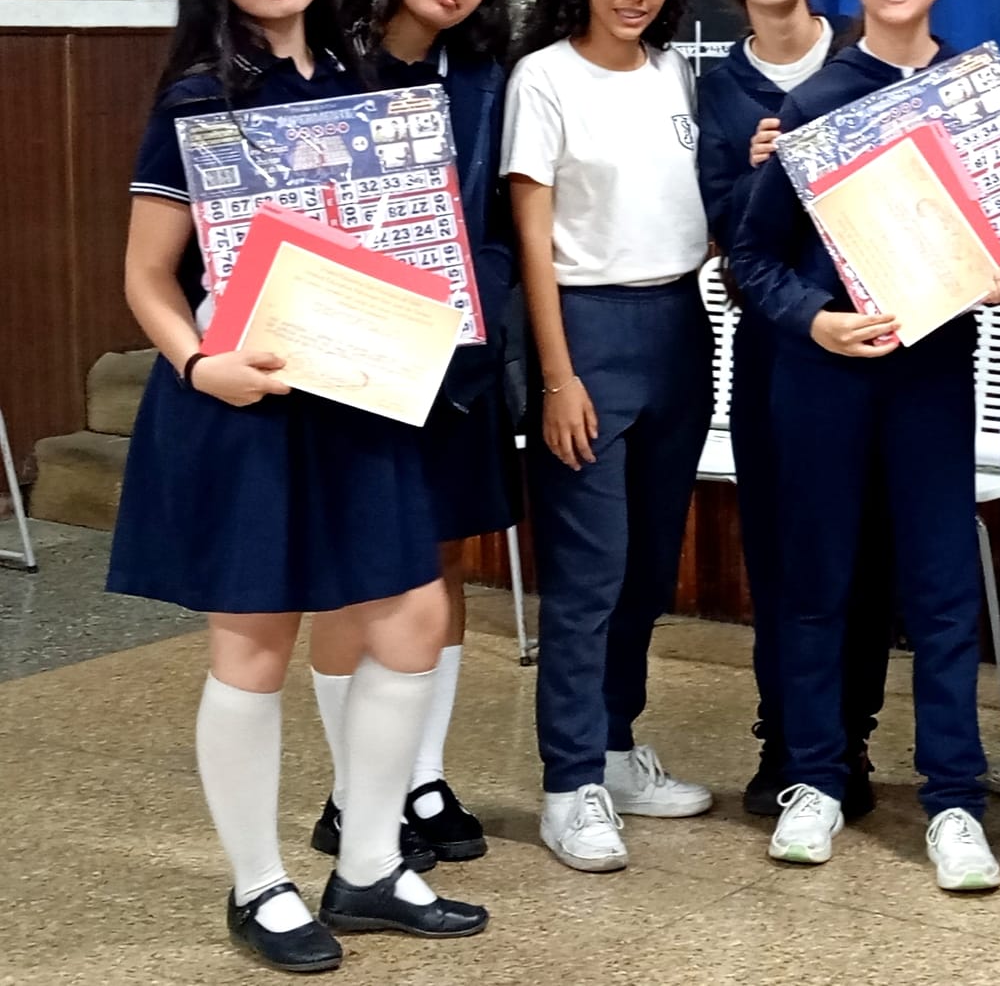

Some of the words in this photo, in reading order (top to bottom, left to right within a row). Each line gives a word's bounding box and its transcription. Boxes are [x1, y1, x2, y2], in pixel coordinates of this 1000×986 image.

[982, 124, 999, 137] 34
[359, 180, 378, 193] 32
[383, 177, 400, 190] 33
[982, 174, 1000, 187] 23
[231, 199, 250, 212] 67
[279, 192, 298, 205] 69
[392, 228, 410, 240] 23
[414, 224, 433, 237] 24
